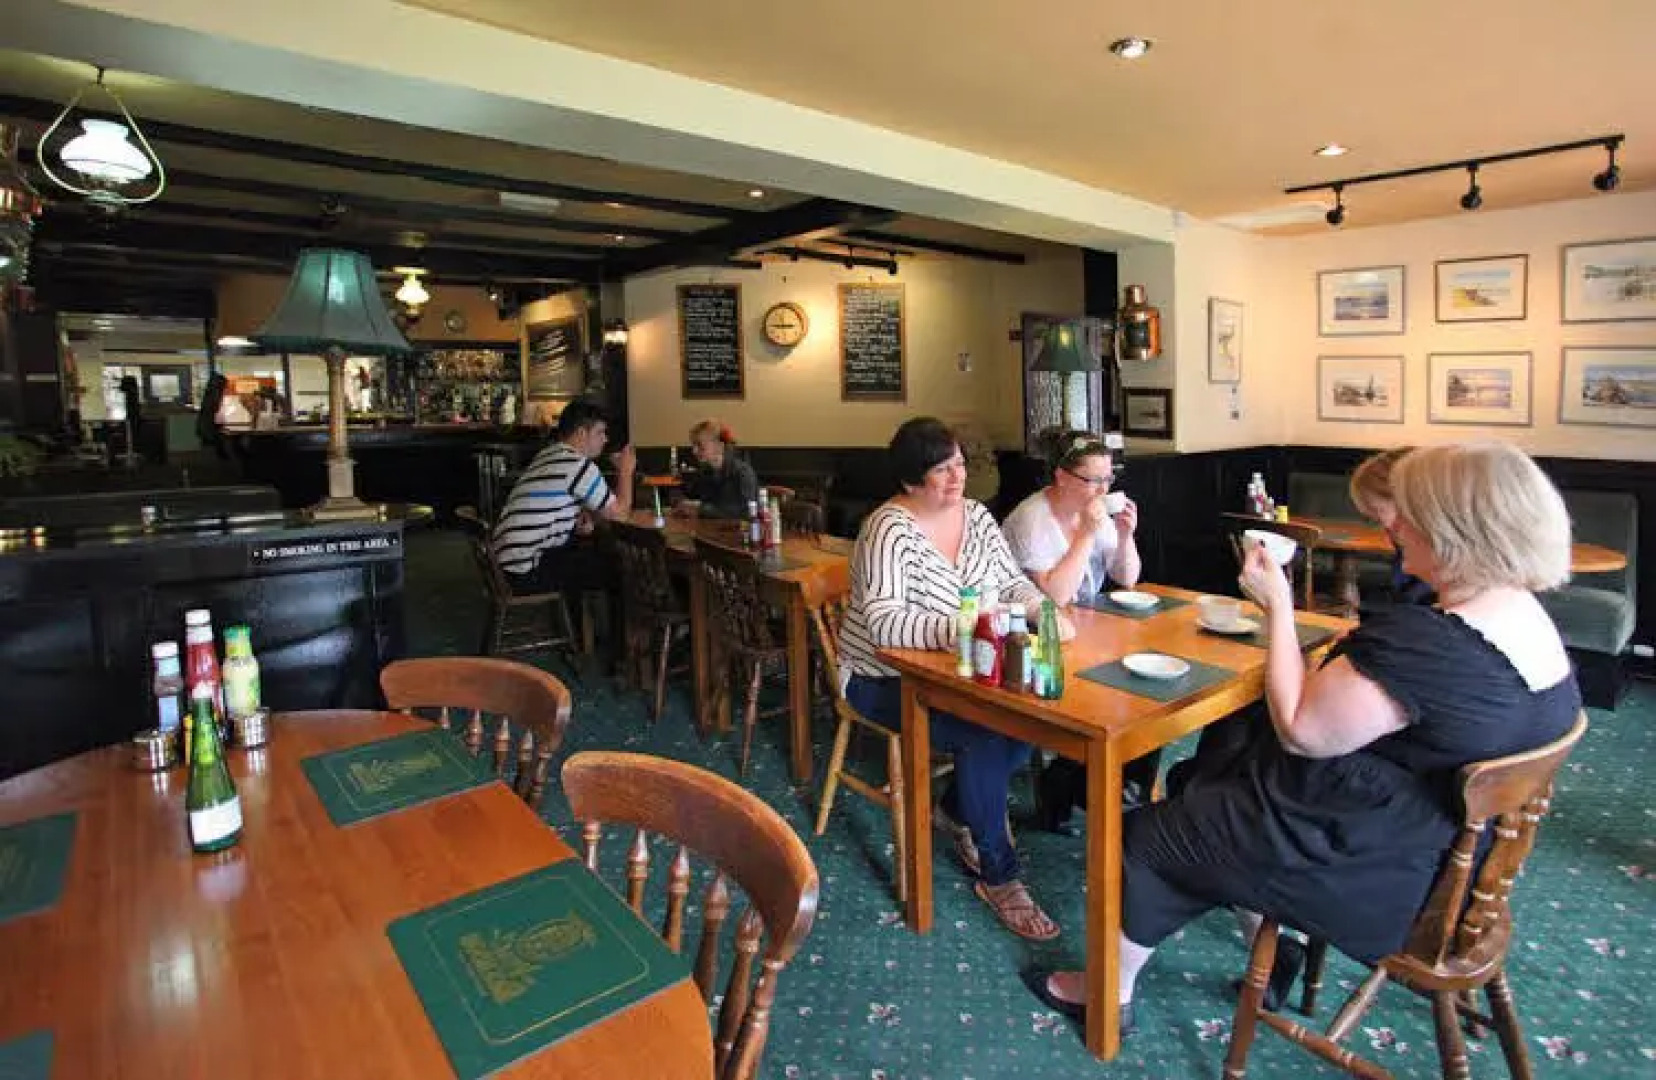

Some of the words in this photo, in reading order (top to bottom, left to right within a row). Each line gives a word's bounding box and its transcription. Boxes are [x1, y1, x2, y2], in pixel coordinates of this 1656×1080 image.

[262, 547, 277, 559] NO
[279, 544, 324, 557] SMOKING
[326, 542, 338, 553] IN
[339, 540, 361, 551] THIS
[363, 538, 389, 549] AREA
